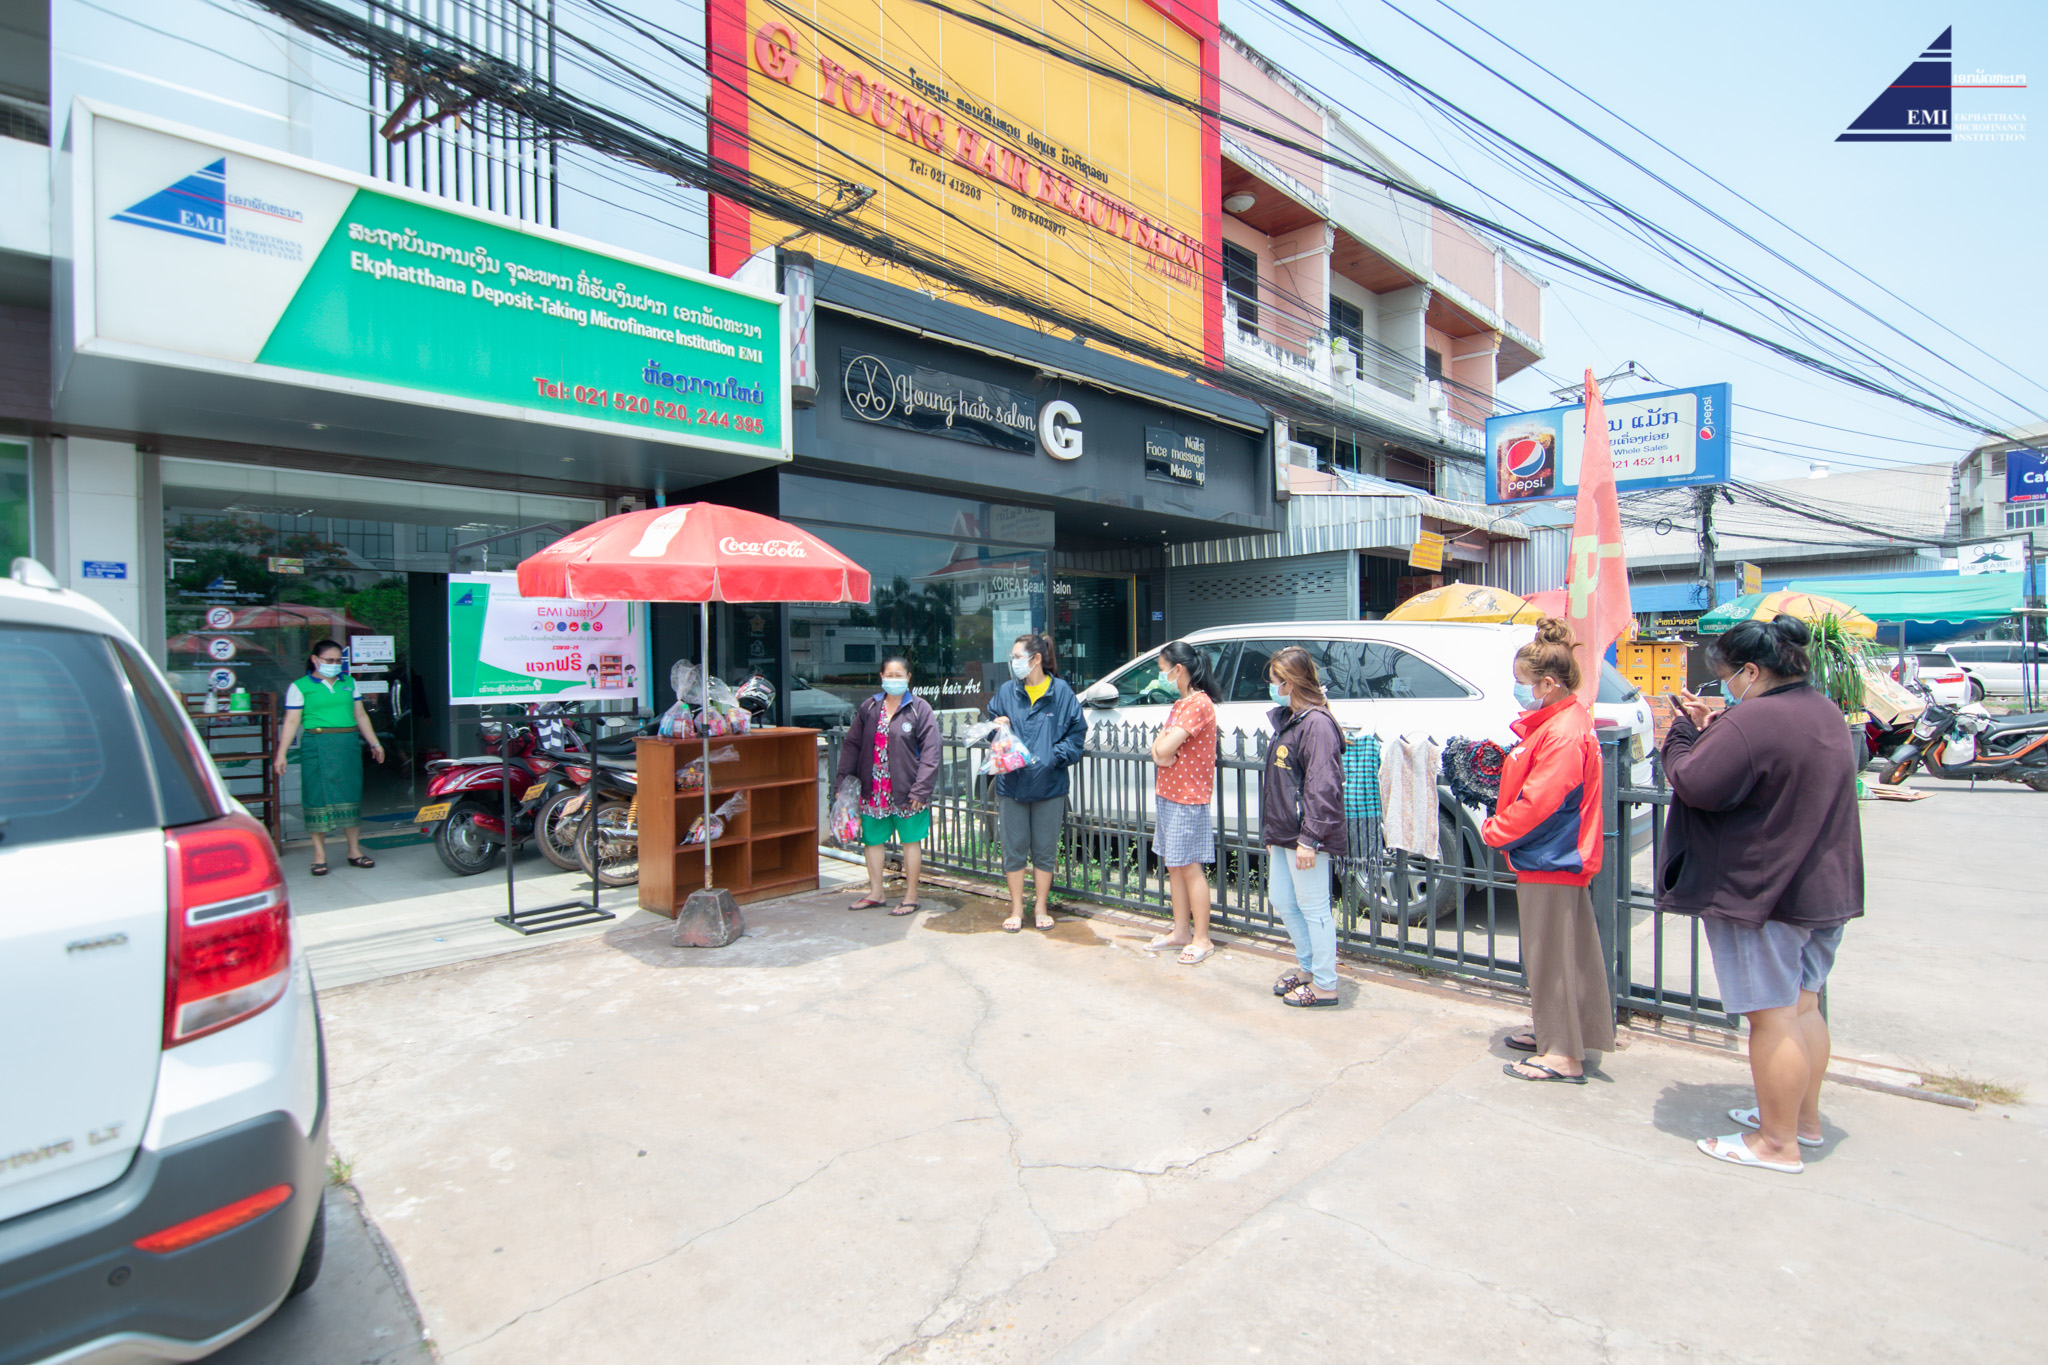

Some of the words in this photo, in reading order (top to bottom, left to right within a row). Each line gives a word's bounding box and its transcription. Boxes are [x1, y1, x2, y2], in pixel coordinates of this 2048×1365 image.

[819, 54, 946, 154] YOUNG
[953, 123, 1031, 194] HAIR
[908, 158, 928, 176] Tel:
[930, 168, 946, 185] 021
[179, 208, 224, 235] EMI
[1145, 253, 1200, 291] ACADEMY
[350, 250, 467, 296] Ekphatthana
[471, 279, 588, 327] Deposit-Taking
[589, 308, 675, 344] Microfinance
[675, 329, 736, 358] Institution
[738, 345, 763, 364] EMI
[533, 376, 571, 400] Tel:
[574, 385, 608, 407] 021
[613, 392, 650, 415] 520
[654, 400, 692, 425] 520,
[696, 408, 730, 429] 244
[733, 414, 764, 434] 395
[895, 374, 957, 427] Young
[959, 389, 994, 423] hair
[995, 402, 1037, 432] salon
[1702, 395, 1714, 425] pepsi
[1146, 441, 1168, 457] Face
[1171, 448, 1205, 468] massage
[1184, 436, 1205, 453] Nails
[1613, 447, 1641, 456] Whole
[1643, 444, 1668, 453] Sales
[1633, 457, 1655, 467] 452
[1660, 454, 1681, 464] 141
[1170, 463, 1193, 479] Make
[1195, 471, 1205, 485] up
[1508, 477, 1543, 493] pepsi
[719, 535, 808, 559] Coca-Cola
[1961, 564, 1979, 572] MR.
[1983, 561, 2021, 570] BARBER
[1023, 578, 1045, 594] Beaut
[1052, 580, 1072, 595] Salon
[537, 607, 562, 617] EMI
[911, 684, 940, 701] young
[942, 678, 962, 695] hair
[962, 677, 982, 695] Art
